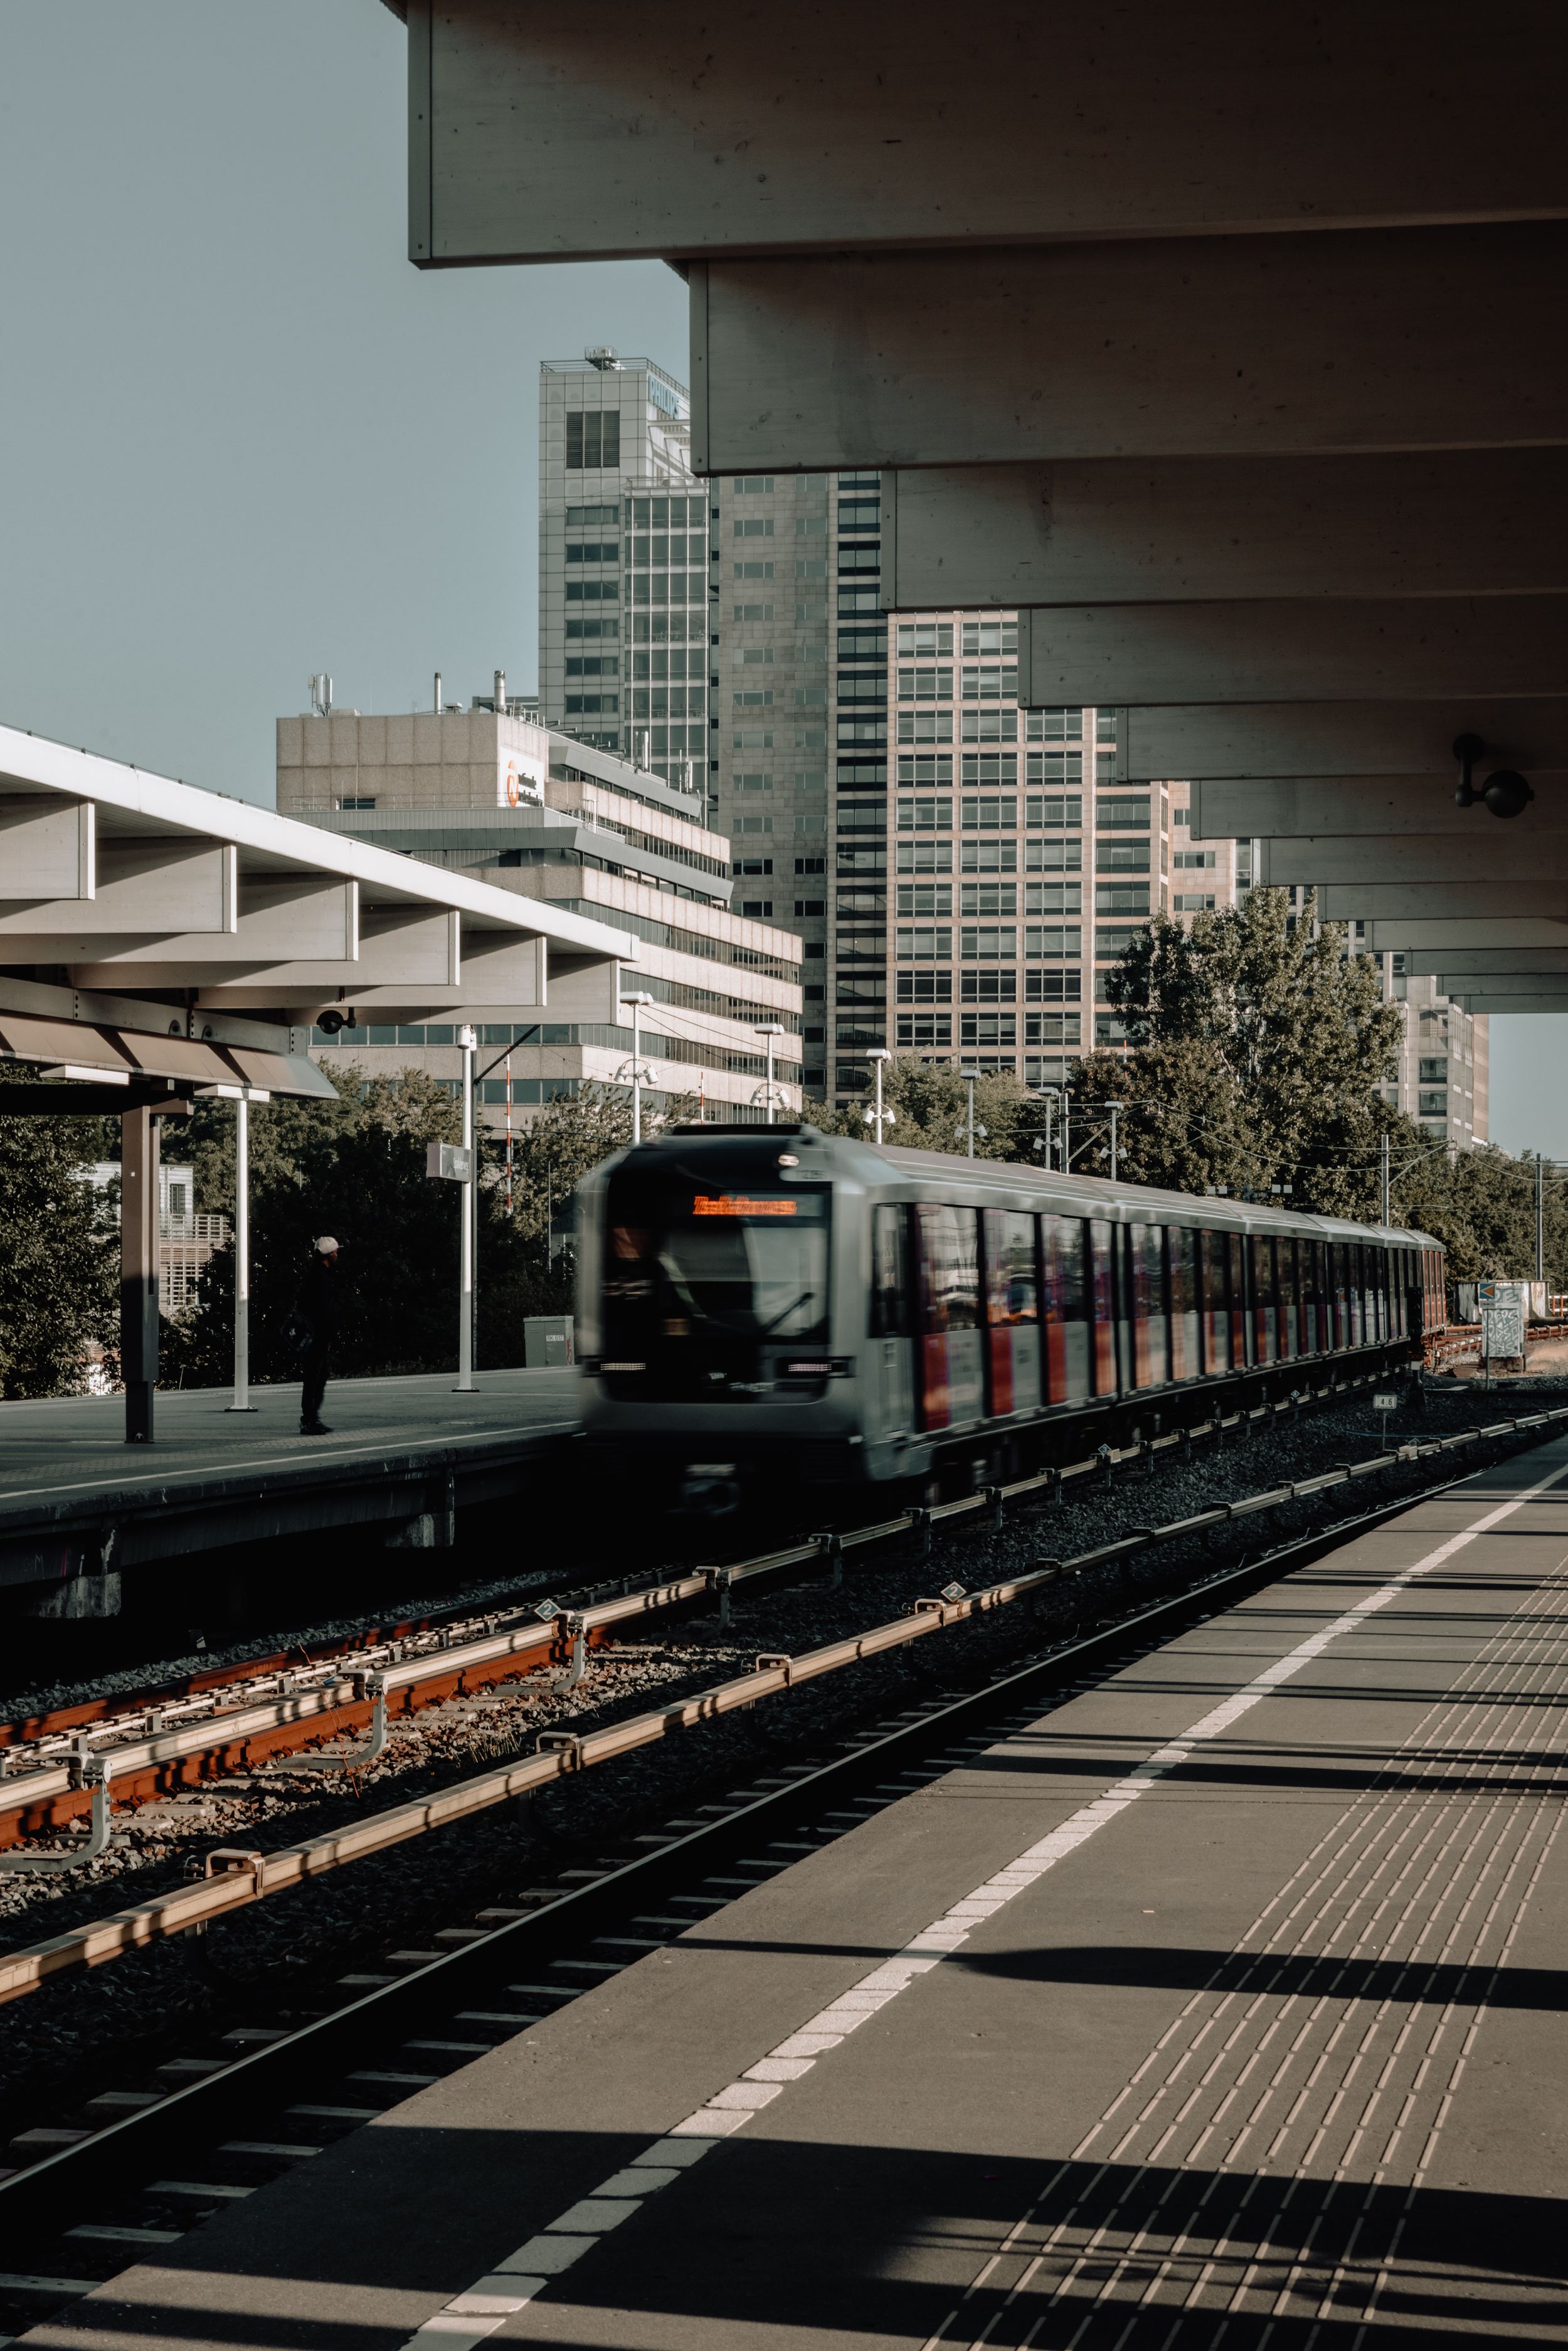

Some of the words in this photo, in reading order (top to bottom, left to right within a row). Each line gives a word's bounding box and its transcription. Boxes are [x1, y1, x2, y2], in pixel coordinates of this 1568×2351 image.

[649, 376, 679, 420] PHILIPS
[949, 1586, 958, 1597] 2
[543, 1603, 552, 1615] 2
